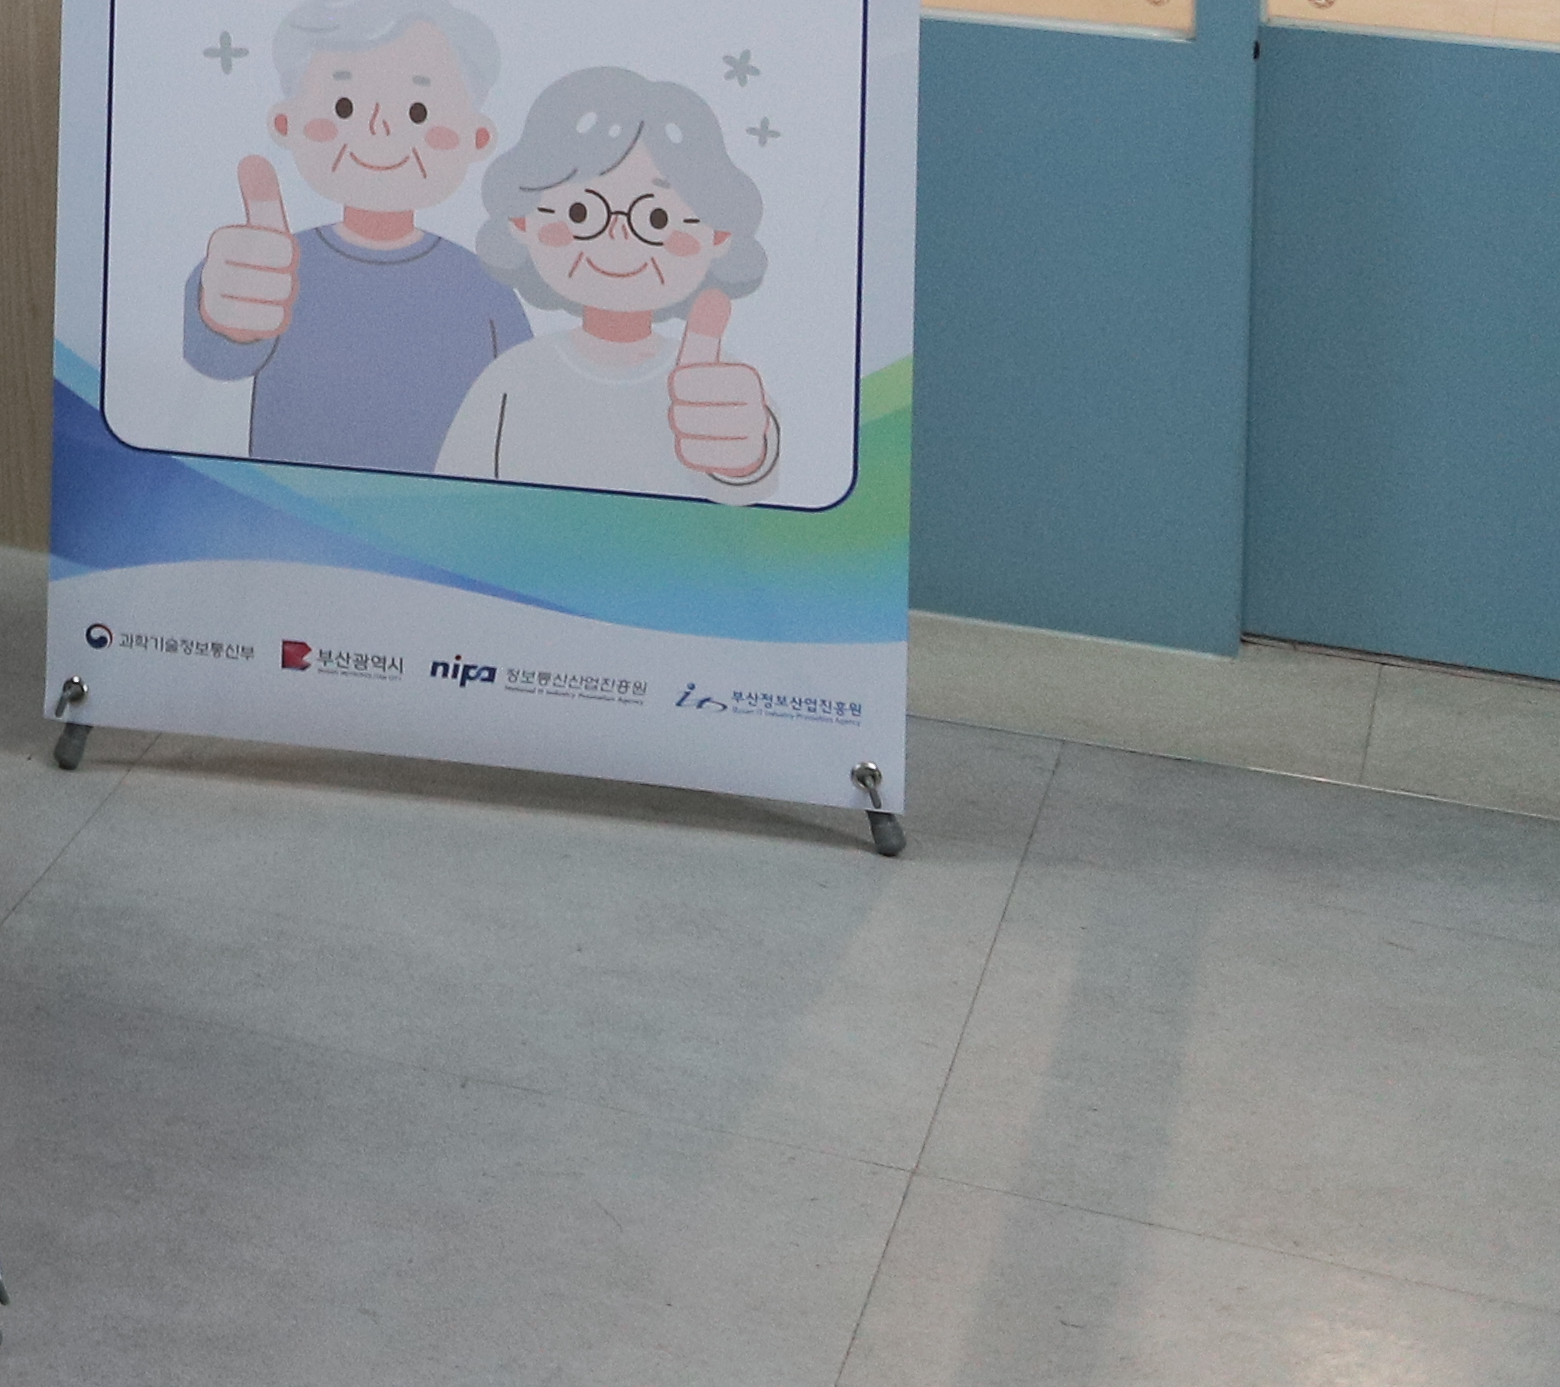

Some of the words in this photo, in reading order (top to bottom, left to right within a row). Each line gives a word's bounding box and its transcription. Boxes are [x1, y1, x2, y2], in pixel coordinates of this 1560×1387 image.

[119, 632, 255, 662] 과학기술정보통신부
[317, 647, 405, 674] 부산광역시
[430, 653, 497, 688] nipa
[505, 667, 648, 696] 정보통신산업진흥원
[732, 690, 863, 718] 부산정보산업진흥원
